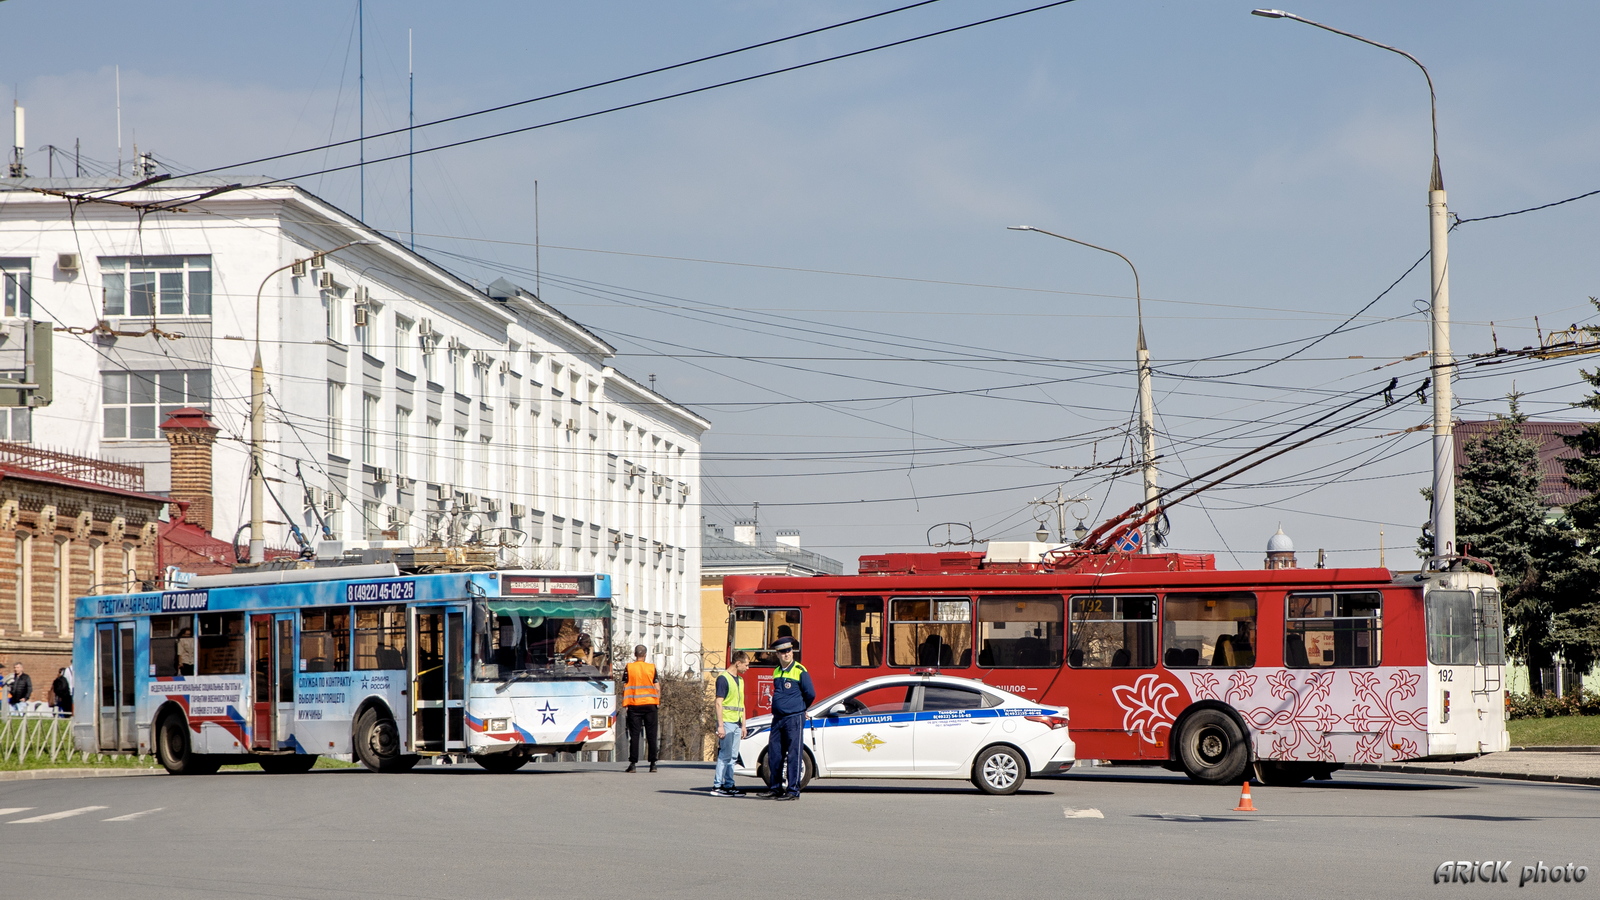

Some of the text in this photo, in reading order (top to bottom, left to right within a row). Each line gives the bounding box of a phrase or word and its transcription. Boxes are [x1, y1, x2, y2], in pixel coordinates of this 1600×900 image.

[542, 578, 548, 592] 1
[348, 582, 414, 601] 8 (4922) 45-02-25
[98, 597, 137, 614] ПРЕСТИЖНАЯ
[138, 596, 160, 612] РАБОТА
[162, 594, 171, 610] ОТ
[171, 594, 176, 609] 2
[177, 593, 189, 609] 000
[1080, 600, 1103, 612] 192
[1438, 669, 1453, 682] 192
[298, 677, 318, 688] СЛУЖБА
[318, 677, 325, 688] ПО
[326, 676, 352, 688] КОНТРАКТУ
[298, 693, 345, 704] ВЫБОР НАСТОЯЩЕГО
[594, 697, 608, 709] 176
[298, 710, 323, 720] МУЖЧИНЫ
[850, 716, 893, 724] ПОЛИЦИЯ
